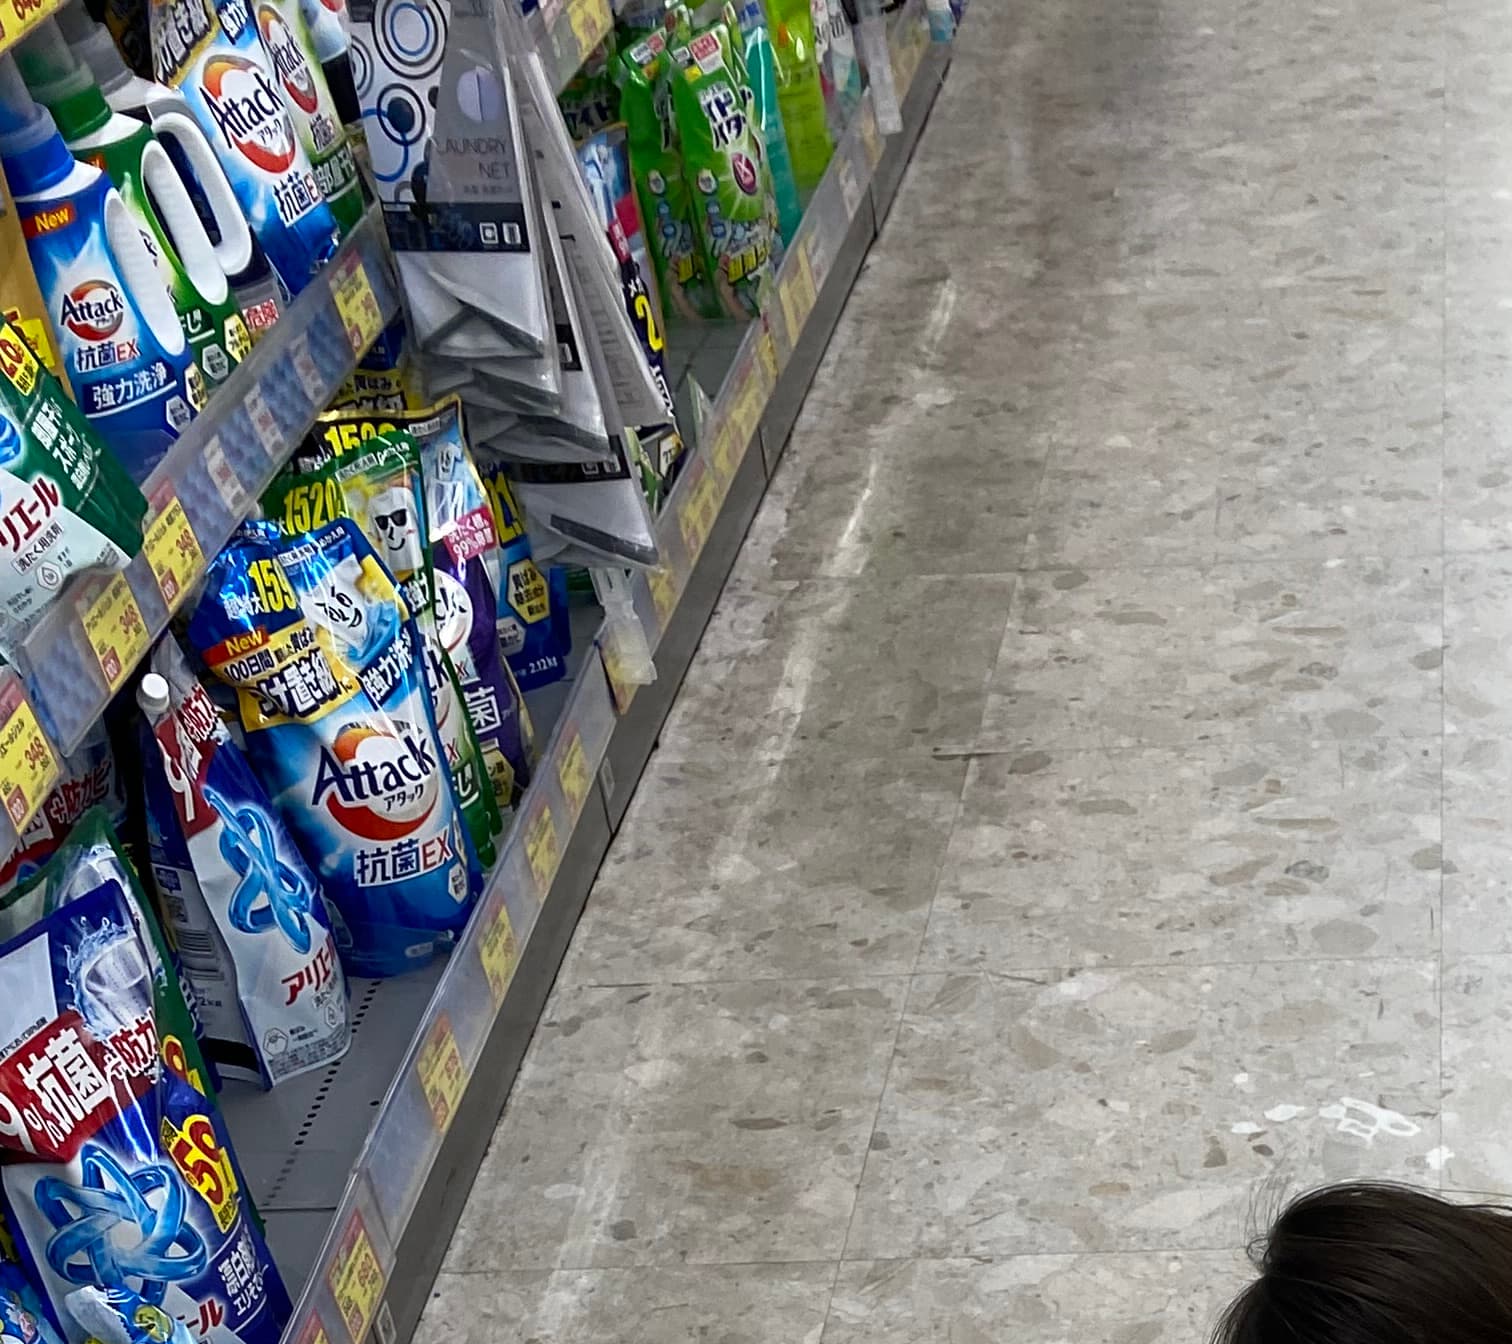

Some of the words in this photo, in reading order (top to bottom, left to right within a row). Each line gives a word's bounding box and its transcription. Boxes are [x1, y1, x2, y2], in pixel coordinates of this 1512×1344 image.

[273, 25, 305, 86] Attack
[200, 72, 285, 149] Attack
[478, 161, 511, 180] NET
[35, 207, 70, 232] New
[61, 289, 124, 326] Attack
[77, 338, 141, 371] 抗菌EX
[92, 362, 169, 411] 強力洗浄
[0, 477, 60, 553] リエール
[223, 647, 275, 683] 100日間
[225, 629, 265, 657] New
[362, 626, 414, 700] 強力洗
[312, 735, 436, 806] Attack
[383, 783, 425, 812] アタック
[356, 829, 453, 886] 抗菌EX
[0, 1026, 113, 1155] 9%抗菌
